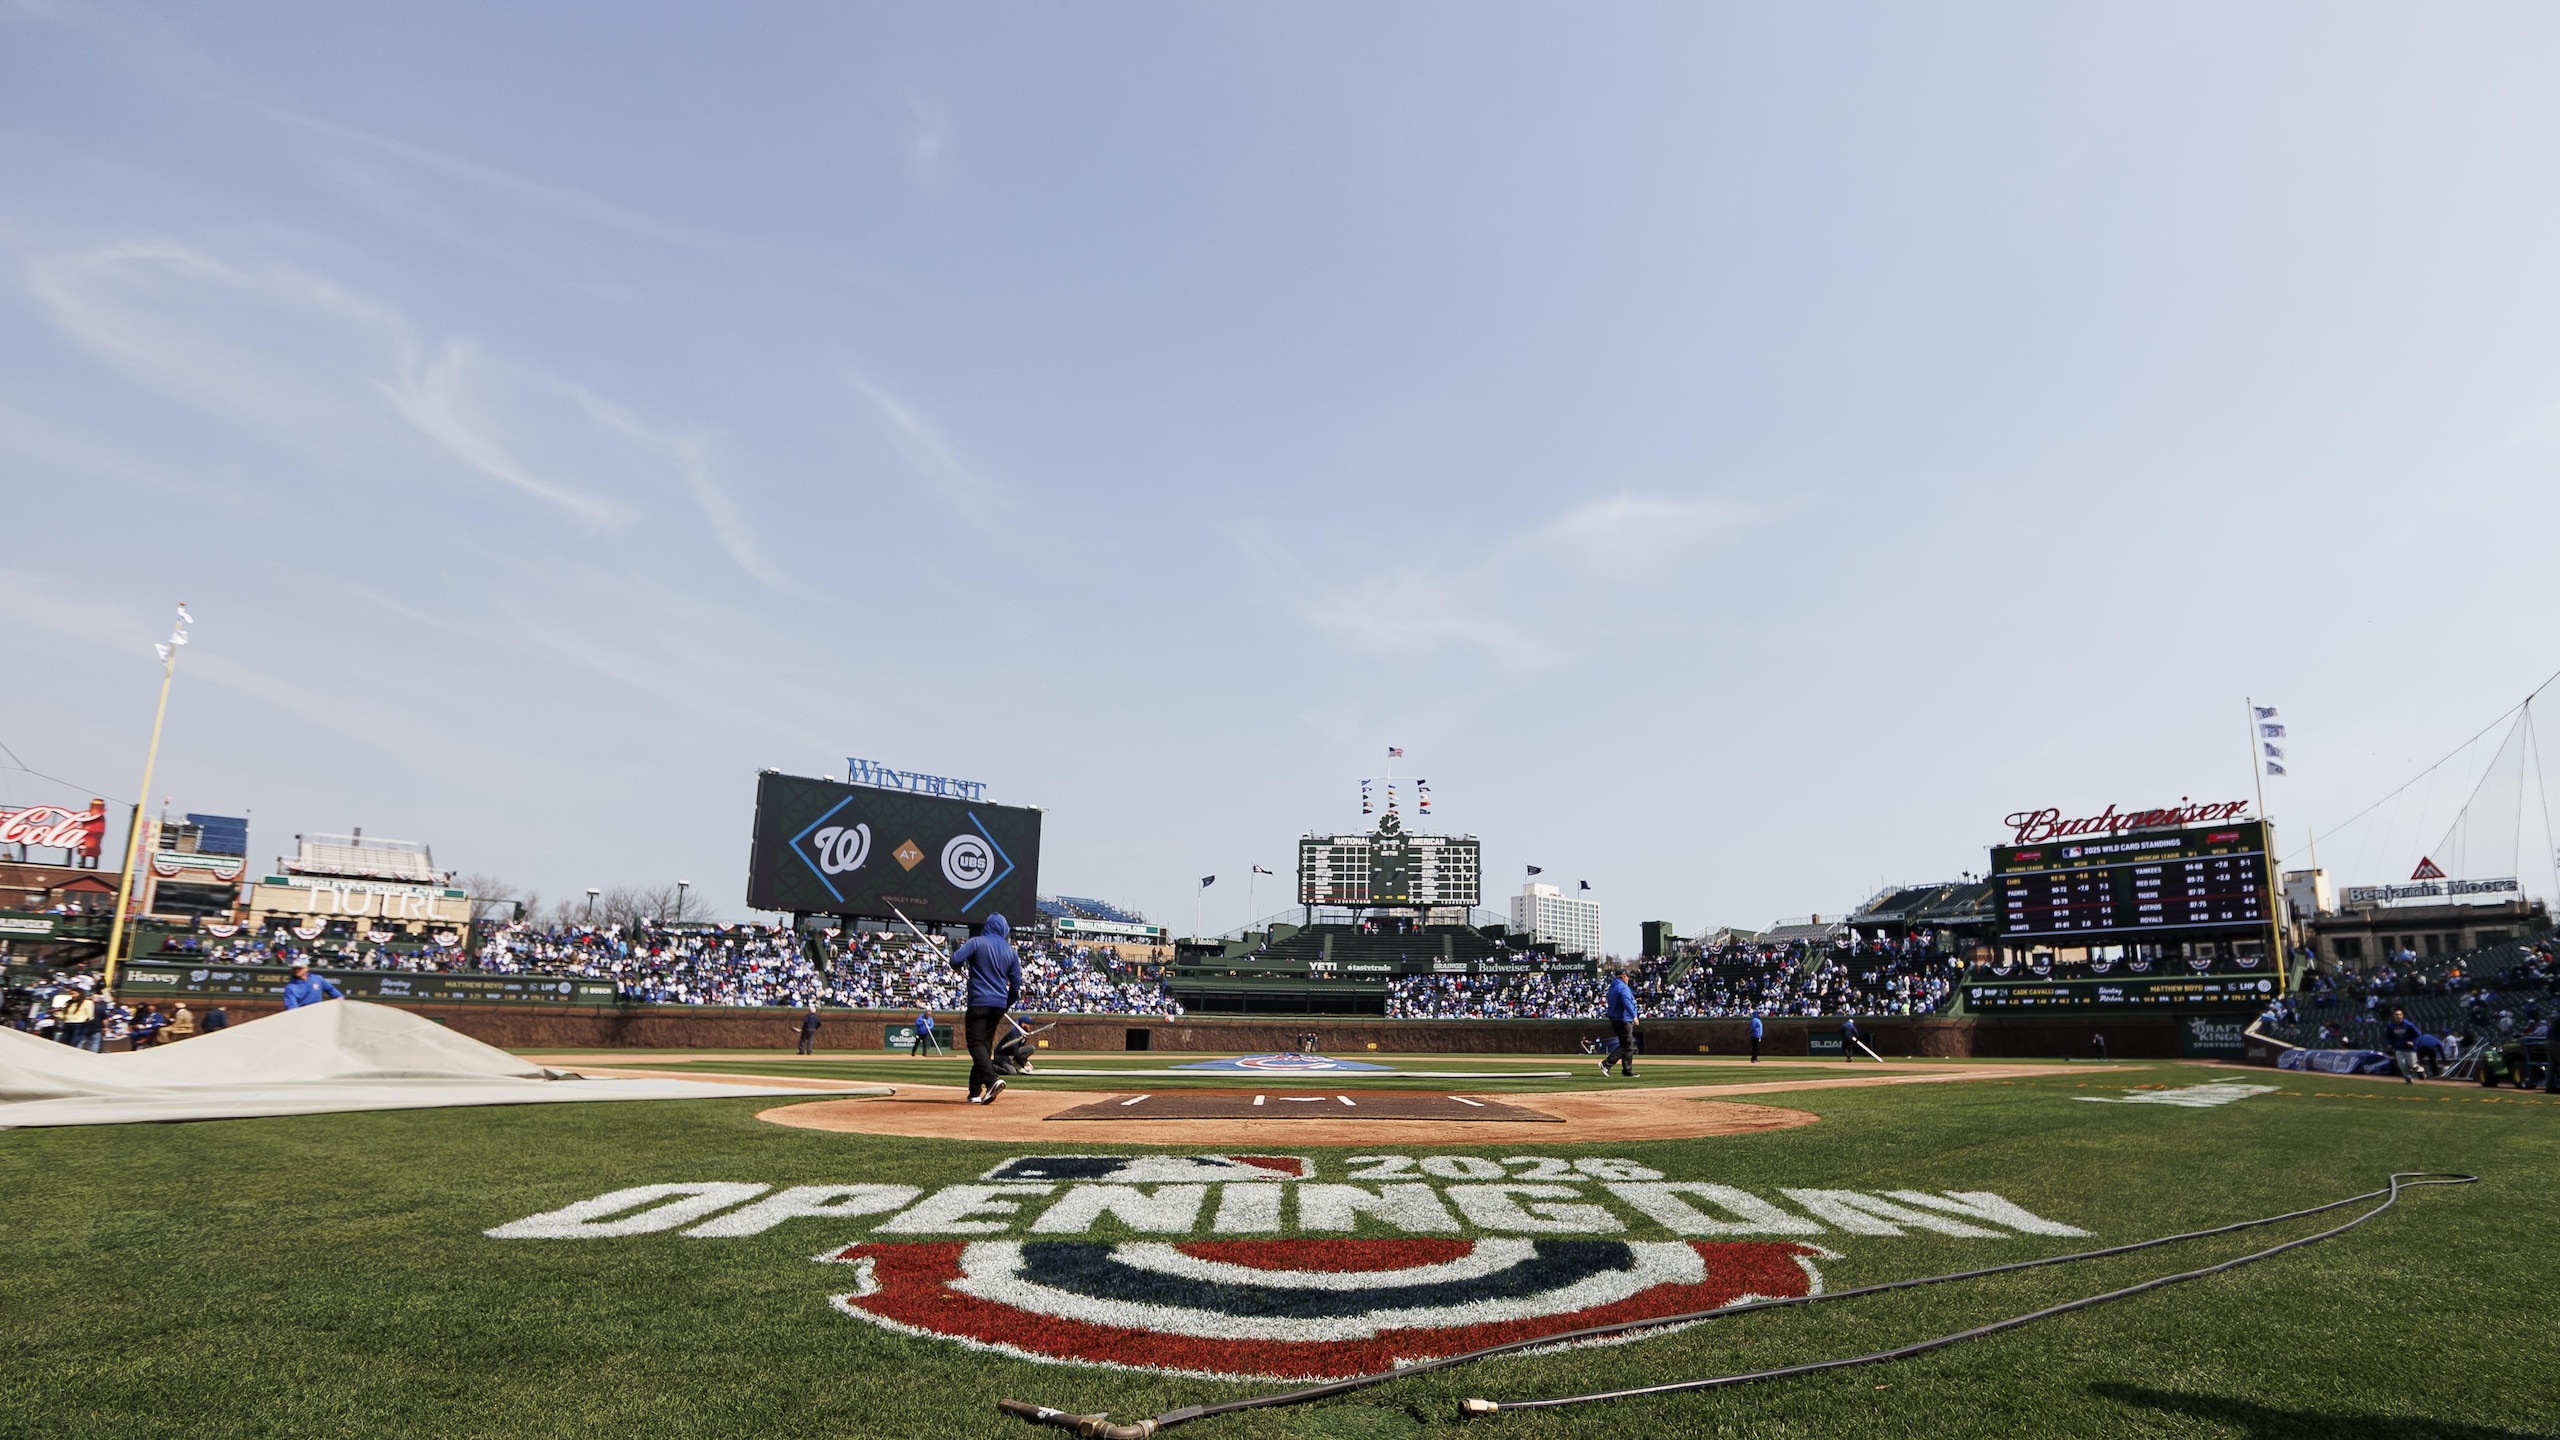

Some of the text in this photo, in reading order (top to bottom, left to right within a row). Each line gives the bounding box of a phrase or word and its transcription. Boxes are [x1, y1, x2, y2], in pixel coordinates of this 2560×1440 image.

[846, 757, 986, 800] WINTRUST
[2004, 797, 2248, 845] Budweiser
[1334, 837, 1371, 845] NATIONAL
[1408, 838, 1446, 846] AMERICAN
[2084, 838, 2181, 855] 2025 WILD CARD STANDINGS
[900, 850, 917, 860] AT
[2161, 852, 2180, 860] LEAGUE
[2135, 866, 2162, 875] YANKEES
[2138, 891, 2158, 899] TIGERS
[2349, 880, 2518, 903] Benjamin Moore
[2139, 904, 2162, 912] ASTROS
[2140, 916, 2163, 924] ROYALS
[1074, 920, 1147, 934] WRIGLEYROOFTOPS.COM
[1308, 962, 1337, 971] YETI
[1353, 963, 1391, 972] tastytrade
[1478, 961, 1530, 972] Budweiser
[1551, 962, 1585, 970] Advocate
[127, 971, 181, 985] Harvey
[445, 980, 482, 989] MATTHEW
[541, 983, 557, 991] LHP
[2150, 985, 2183, 993] MATTHEW
[2184, 984, 2203, 992] BOYD
[2240, 983, 2255, 991] LHP
[2192, 1024, 2243, 1035] DRAFT
[889, 1034, 916, 1044] Gallagh
[2199, 1033, 2242, 1041] KINGS
[483, 1180, 2098, 1241] OPENING DAY
